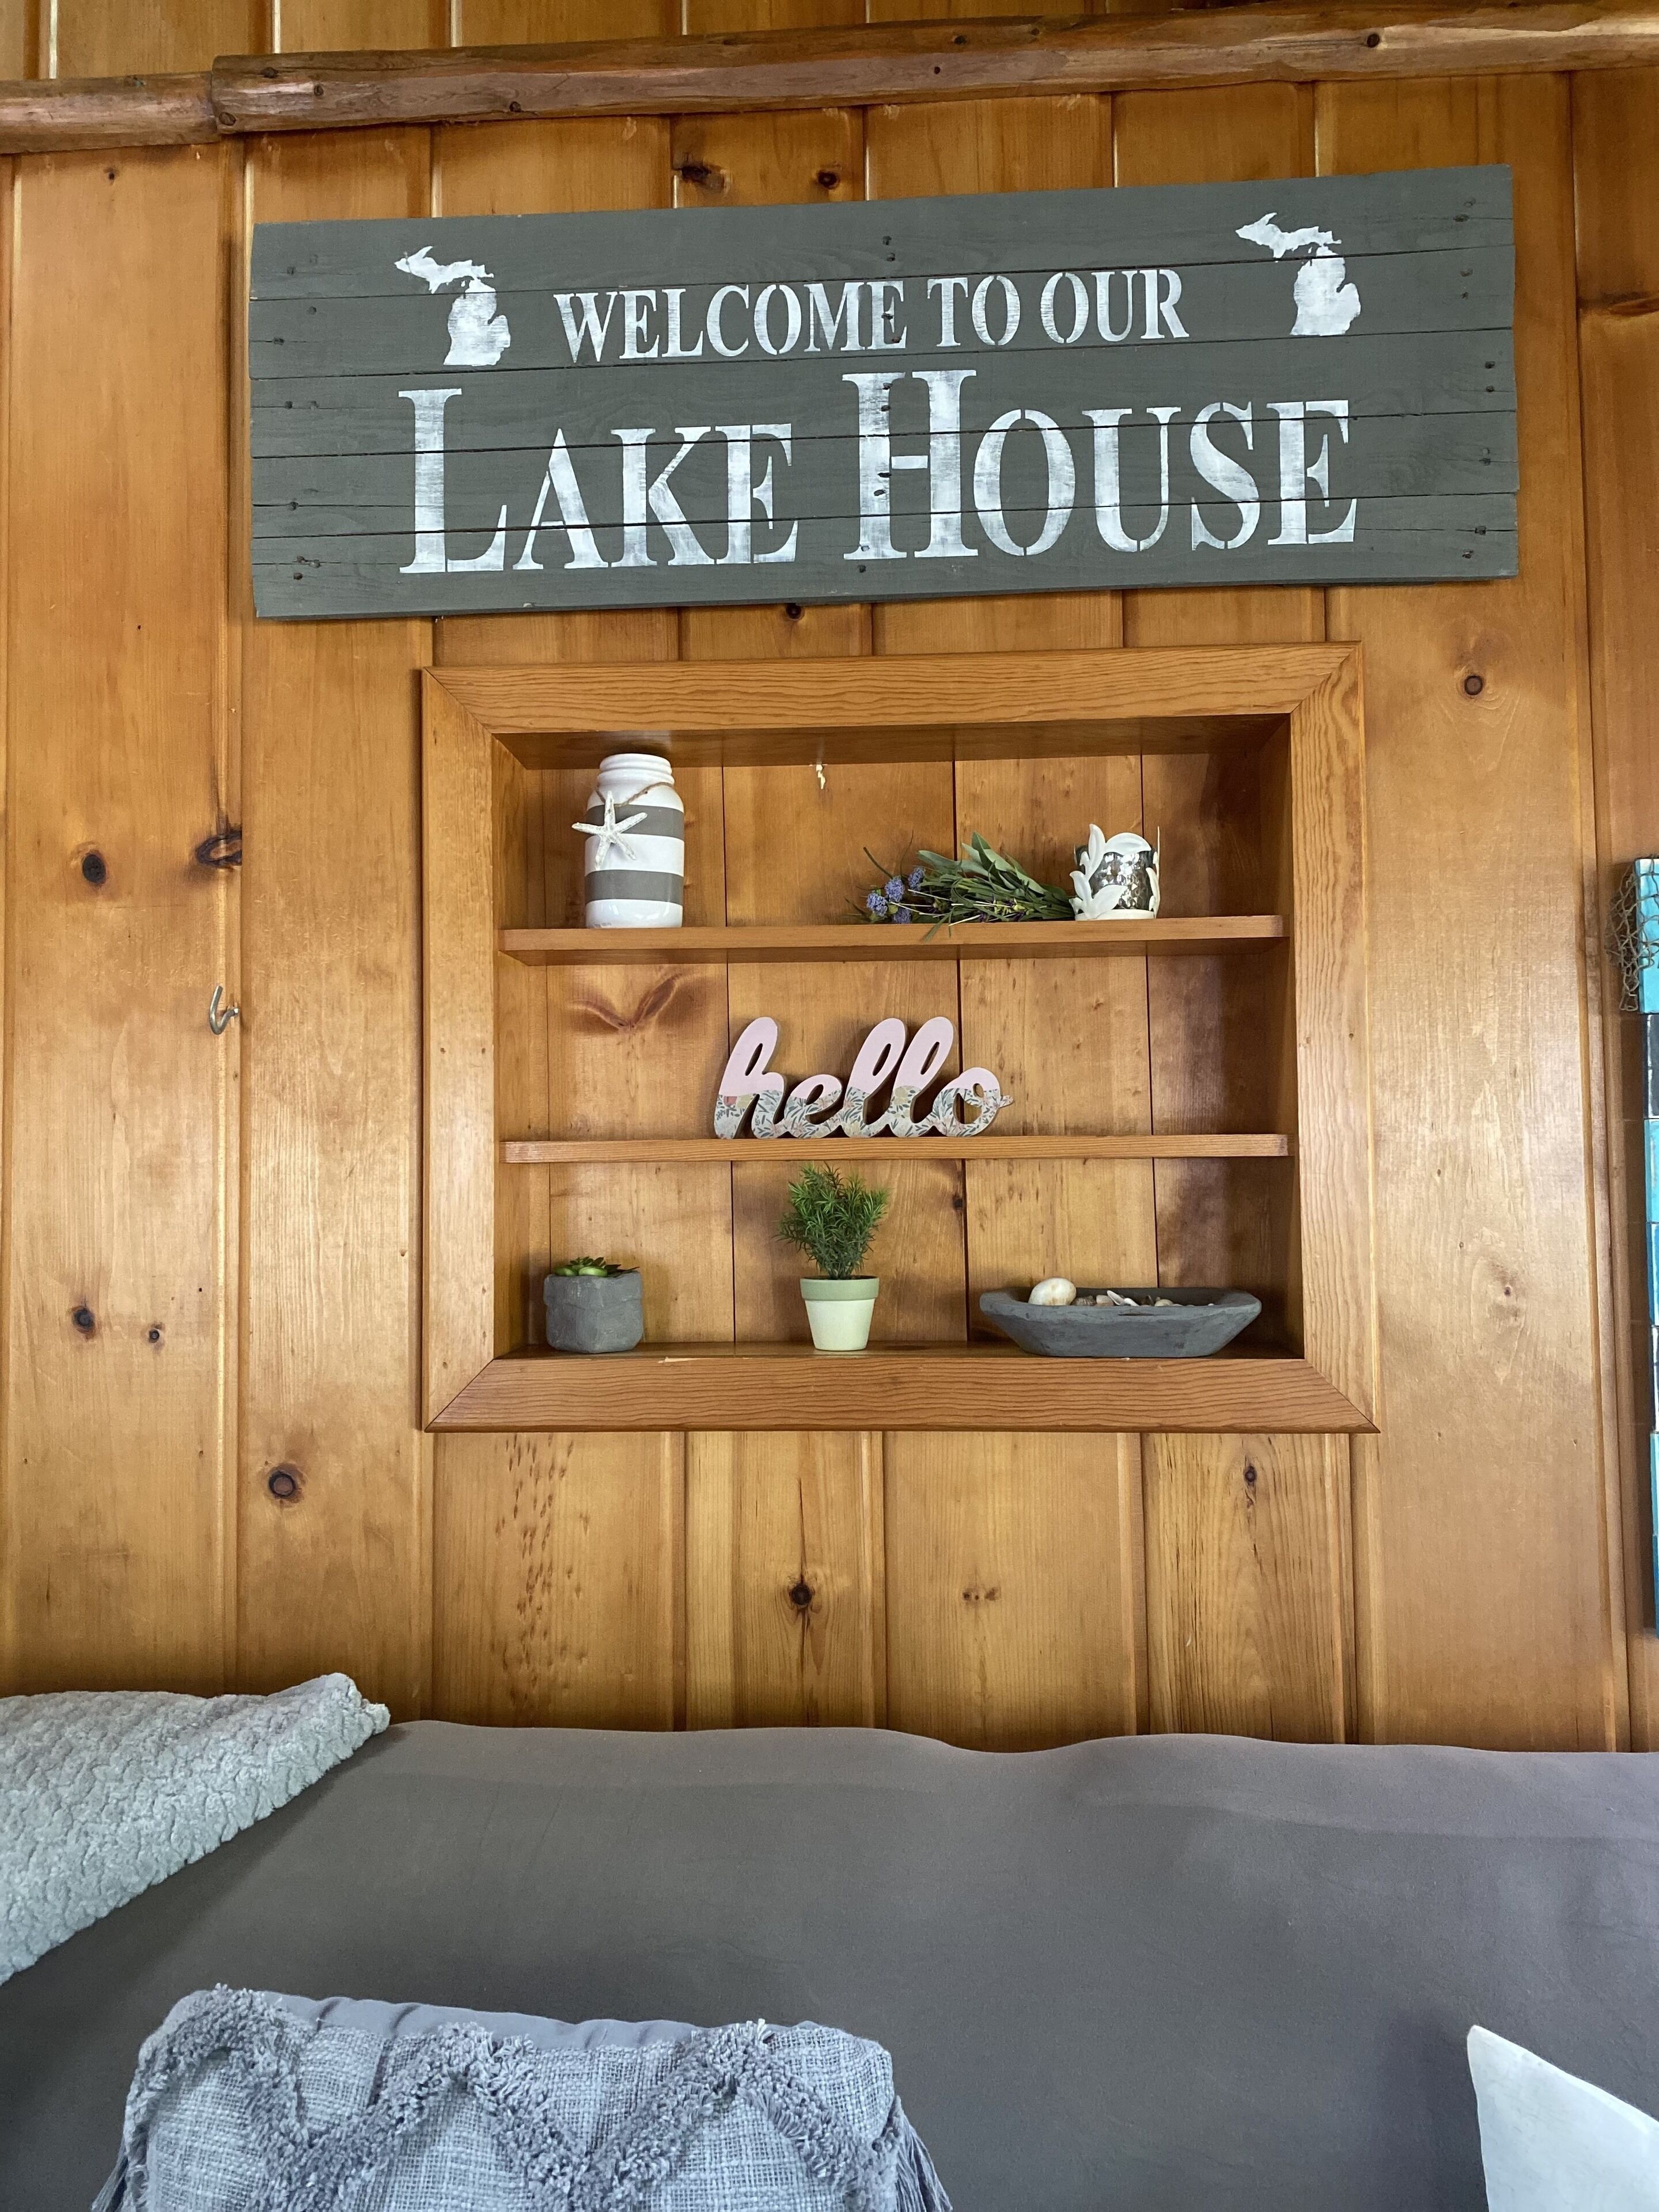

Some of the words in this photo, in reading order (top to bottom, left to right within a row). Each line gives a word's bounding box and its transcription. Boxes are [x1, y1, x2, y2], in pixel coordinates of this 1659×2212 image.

[553, 281, 907, 363] WELCOME
[927, 275, 1021, 347] TO
[1040, 269, 1190, 346] OUR
[398, 388, 799, 574] LAKE
[842, 369, 1357, 561] HOUSE
[714, 1016, 1014, 1139] hello
